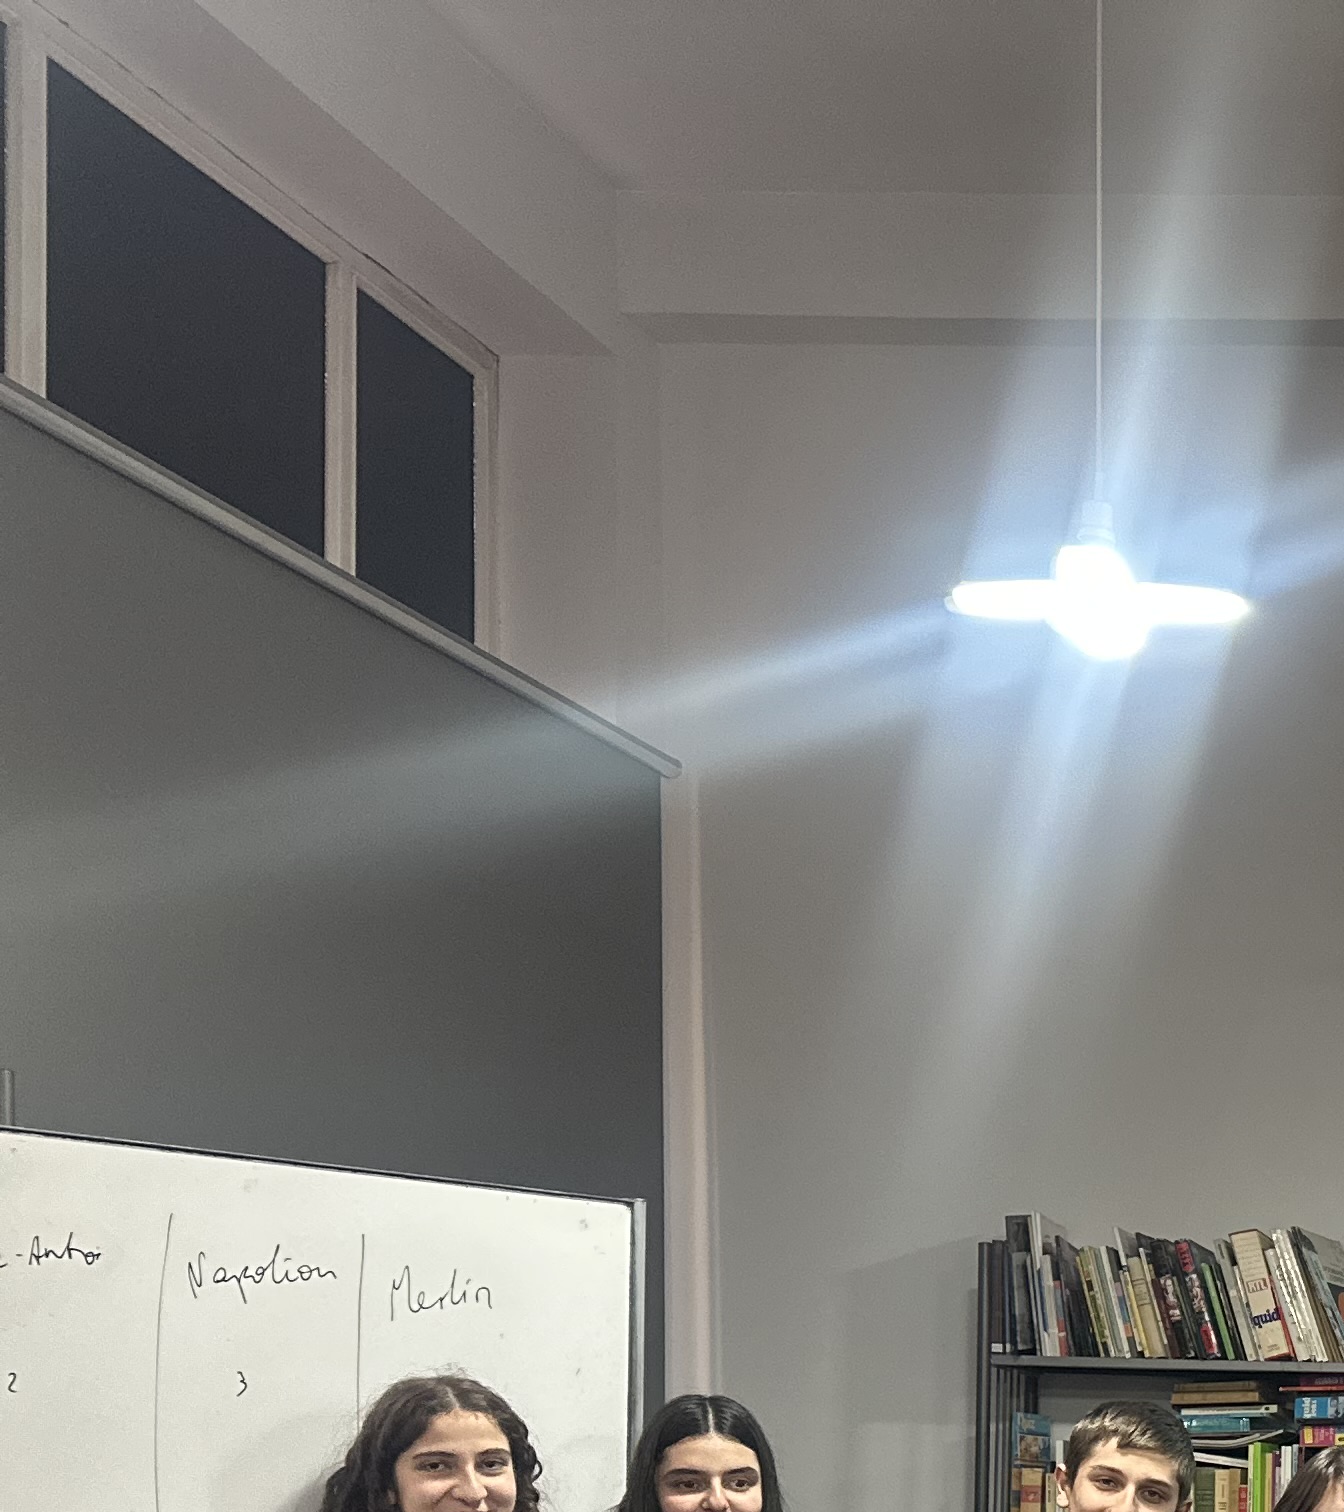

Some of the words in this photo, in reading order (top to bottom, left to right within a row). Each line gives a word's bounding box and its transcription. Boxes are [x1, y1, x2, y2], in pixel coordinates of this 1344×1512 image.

[390, 1266, 492, 1321] Merlin
[7, 1372, 17, 1394] 2
[236, 1371, 248, 1397] 3
